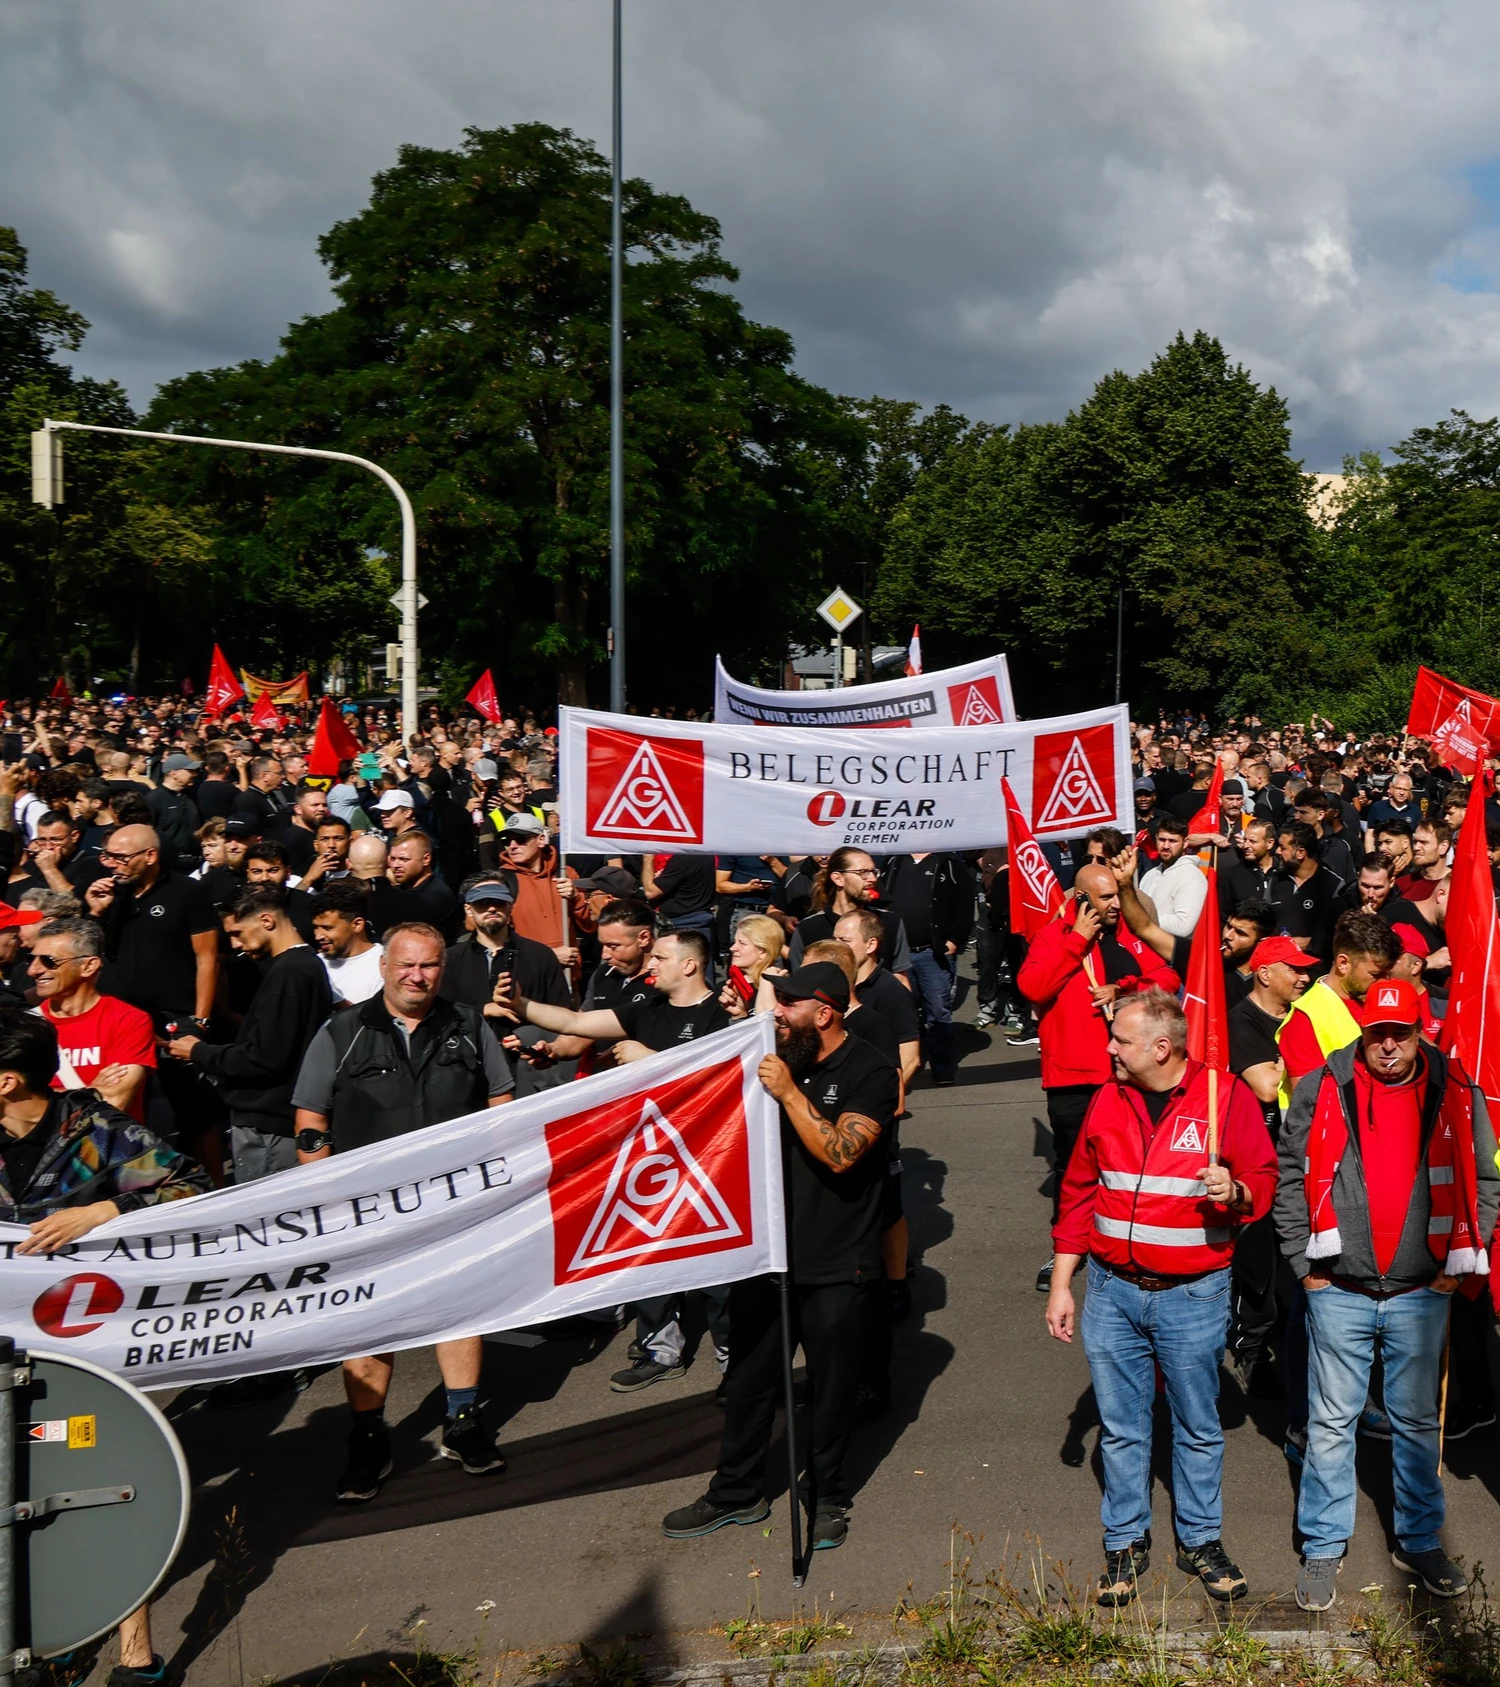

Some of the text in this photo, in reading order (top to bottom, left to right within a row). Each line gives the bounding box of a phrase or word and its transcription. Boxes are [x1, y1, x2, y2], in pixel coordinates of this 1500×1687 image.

[762, 706, 788, 723] WIR
[791, 698, 931, 725] ZUSAMMENHALTEN
[728, 749, 1016, 785] BELEGSCHAFT
[850, 800, 937, 818] LEAR
[843, 833, 900, 844] BREMEN
[847, 819, 955, 832] CORPORATION
[136, 1262, 331, 1311] LEAR
[131, 1283, 375, 1338] CORPORATION
[124, 1330, 254, 1367] BREMEN
